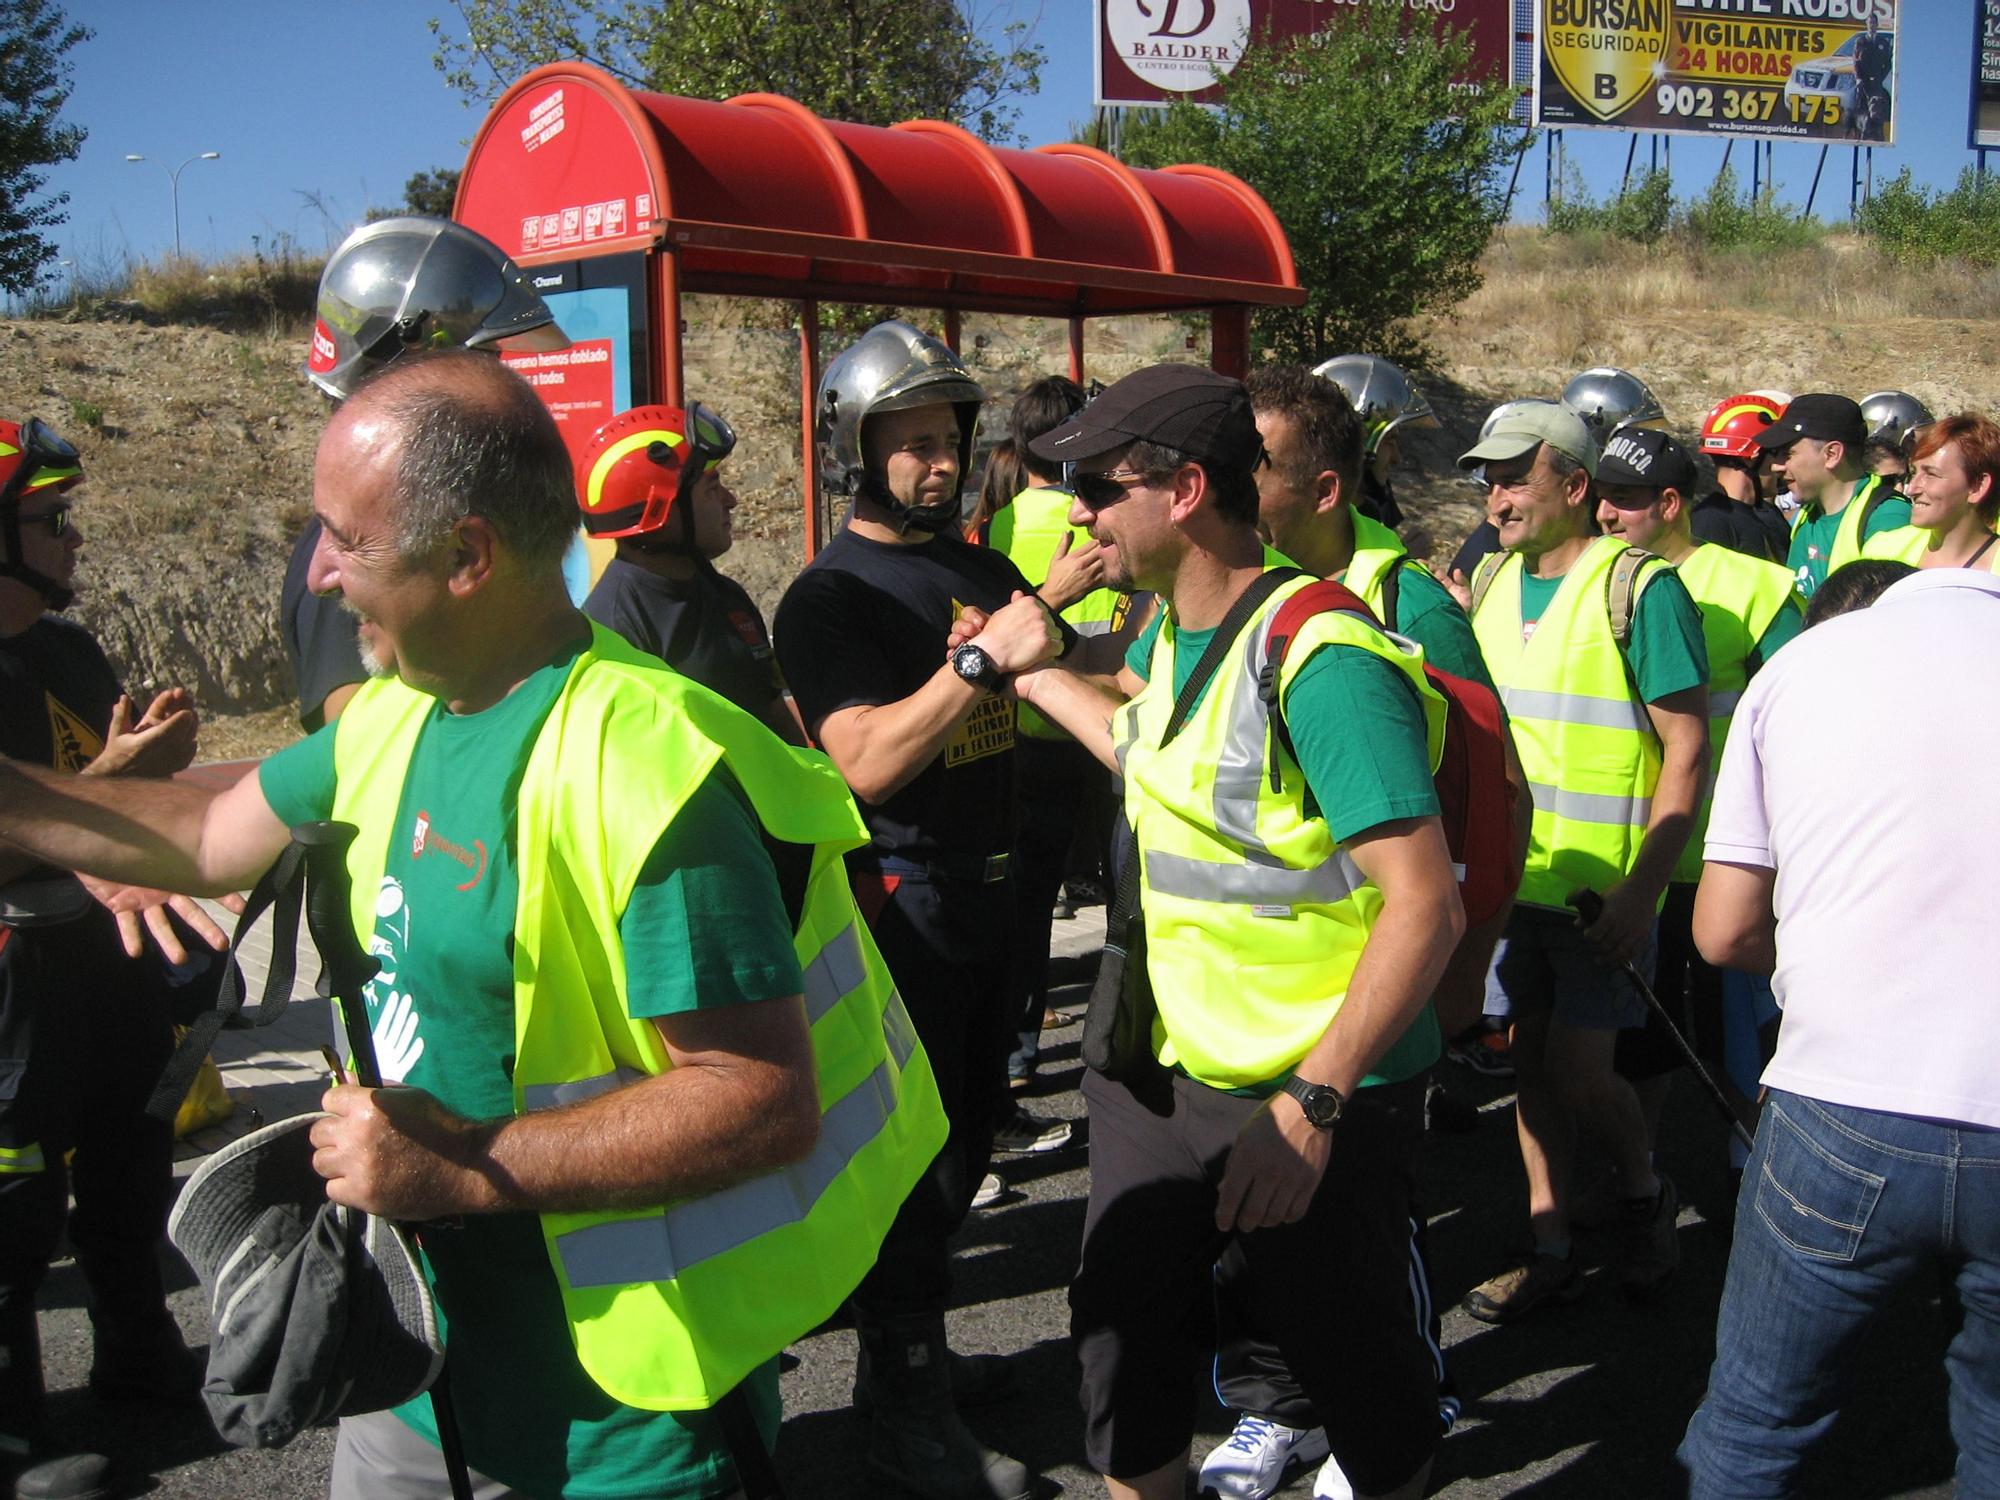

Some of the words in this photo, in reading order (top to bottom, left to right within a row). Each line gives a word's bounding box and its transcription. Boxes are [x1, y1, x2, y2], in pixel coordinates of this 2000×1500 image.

[1551, 0, 1662, 32] BURSAN
[1552, 31, 1660, 53] SEGURIDAD
[1677, 21, 1825, 53] VIGILANTES
[1133, 42, 1229, 60] BALDER
[1676, 47, 1707, 71] 24
[1716, 51, 1792, 77] HORAS
[1137, 62, 1177, 71] CENTRO
[1594, 73, 1618, 99] B
[1656, 84, 1714, 118] 902
[1723, 89, 1779, 121] 367
[1788, 94, 1842, 125] 175
[1707, 121, 1808, 136] www.bursanseguridad.es
[538, 353, 569, 367] hemos
[570, 348, 608, 364] doblado
[539, 371, 565, 385] todos
